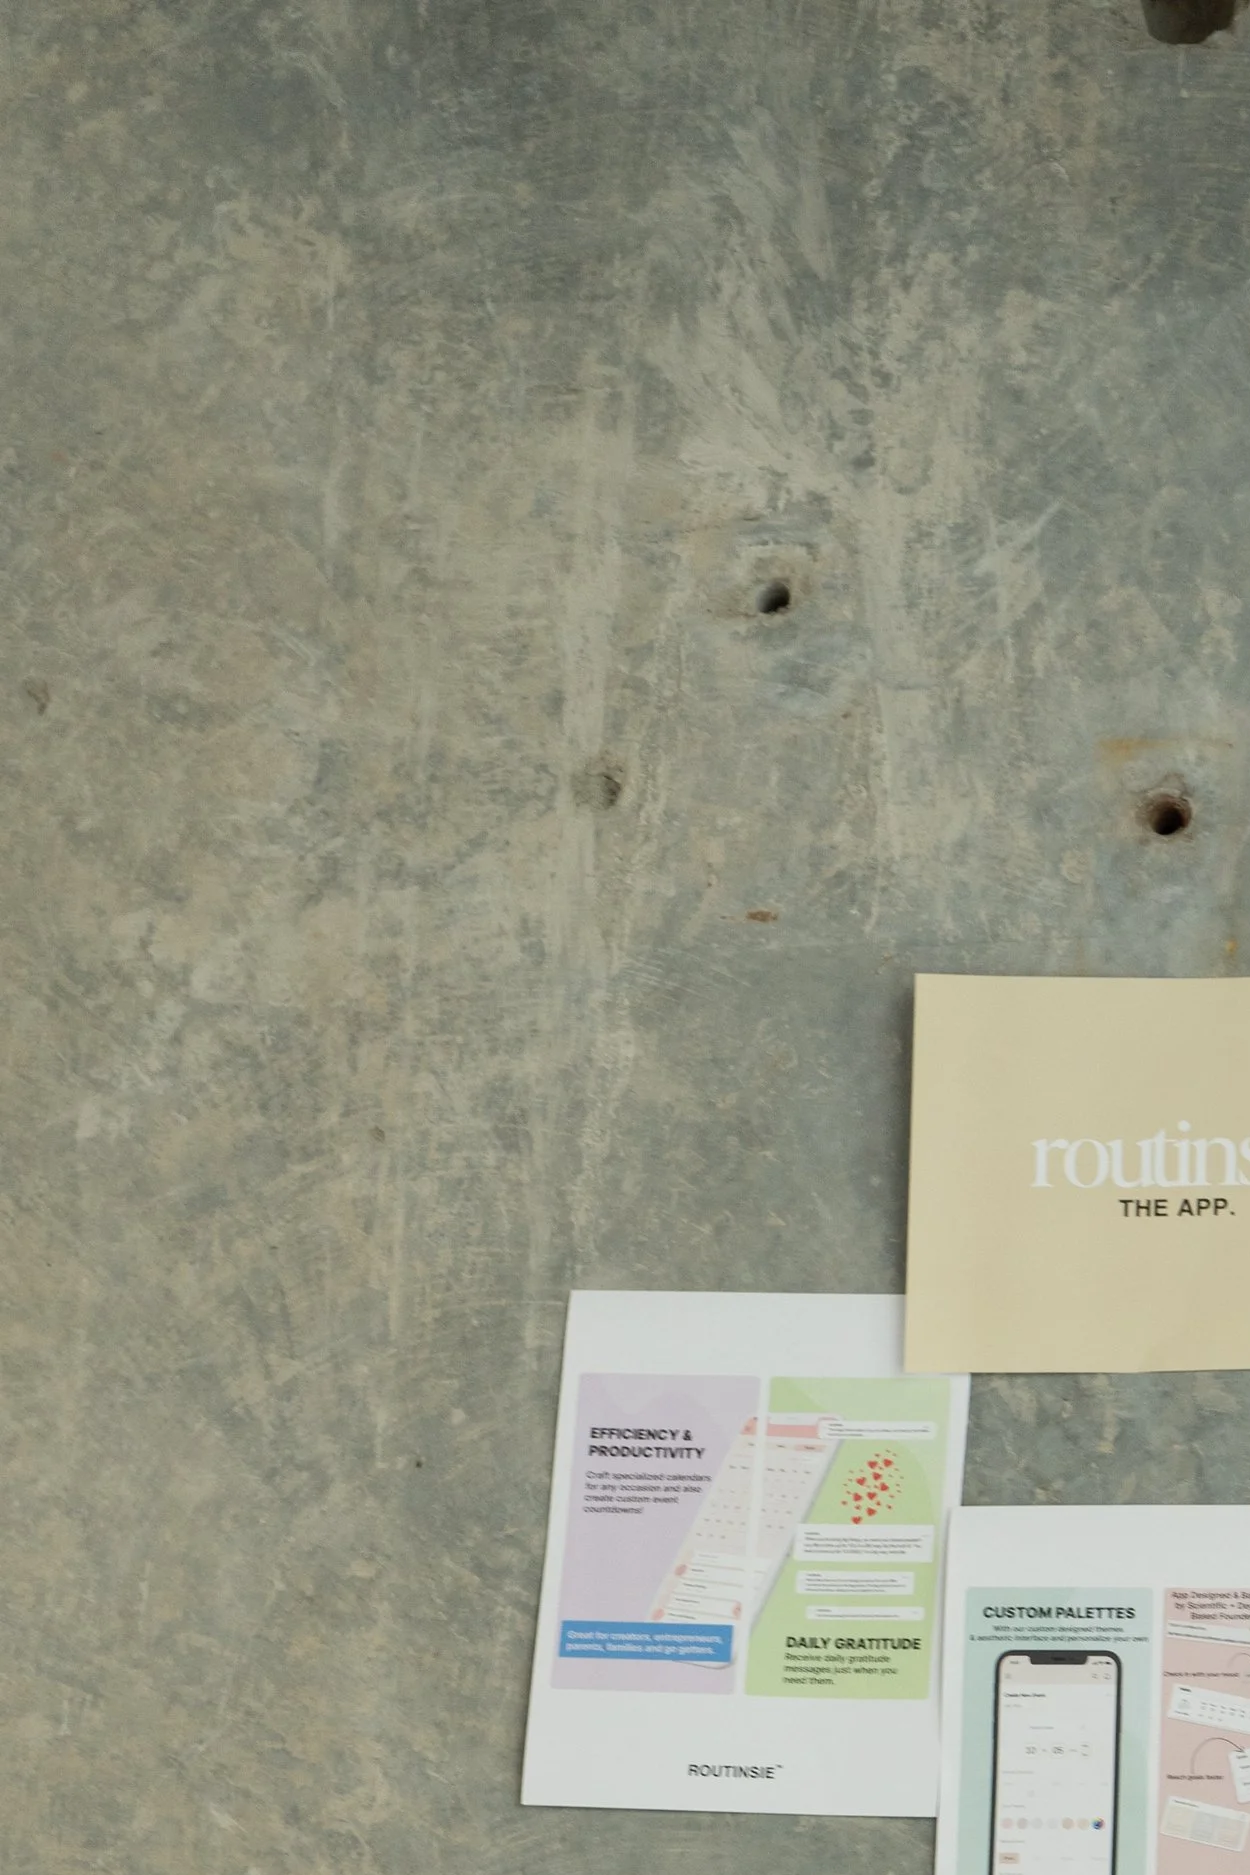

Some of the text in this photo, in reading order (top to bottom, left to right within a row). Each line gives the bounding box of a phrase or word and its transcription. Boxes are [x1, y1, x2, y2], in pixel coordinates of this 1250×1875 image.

[1119, 1198, 1236, 1217] THE APP.
[590, 1427, 693, 1441] EFFICIENCY &
[588, 1445, 706, 1459] PRODUCTIVITY
[982, 1606, 1136, 1620] CUSTOM PALETTES
[786, 1636, 922, 1650] DAILY GRATITUDE
